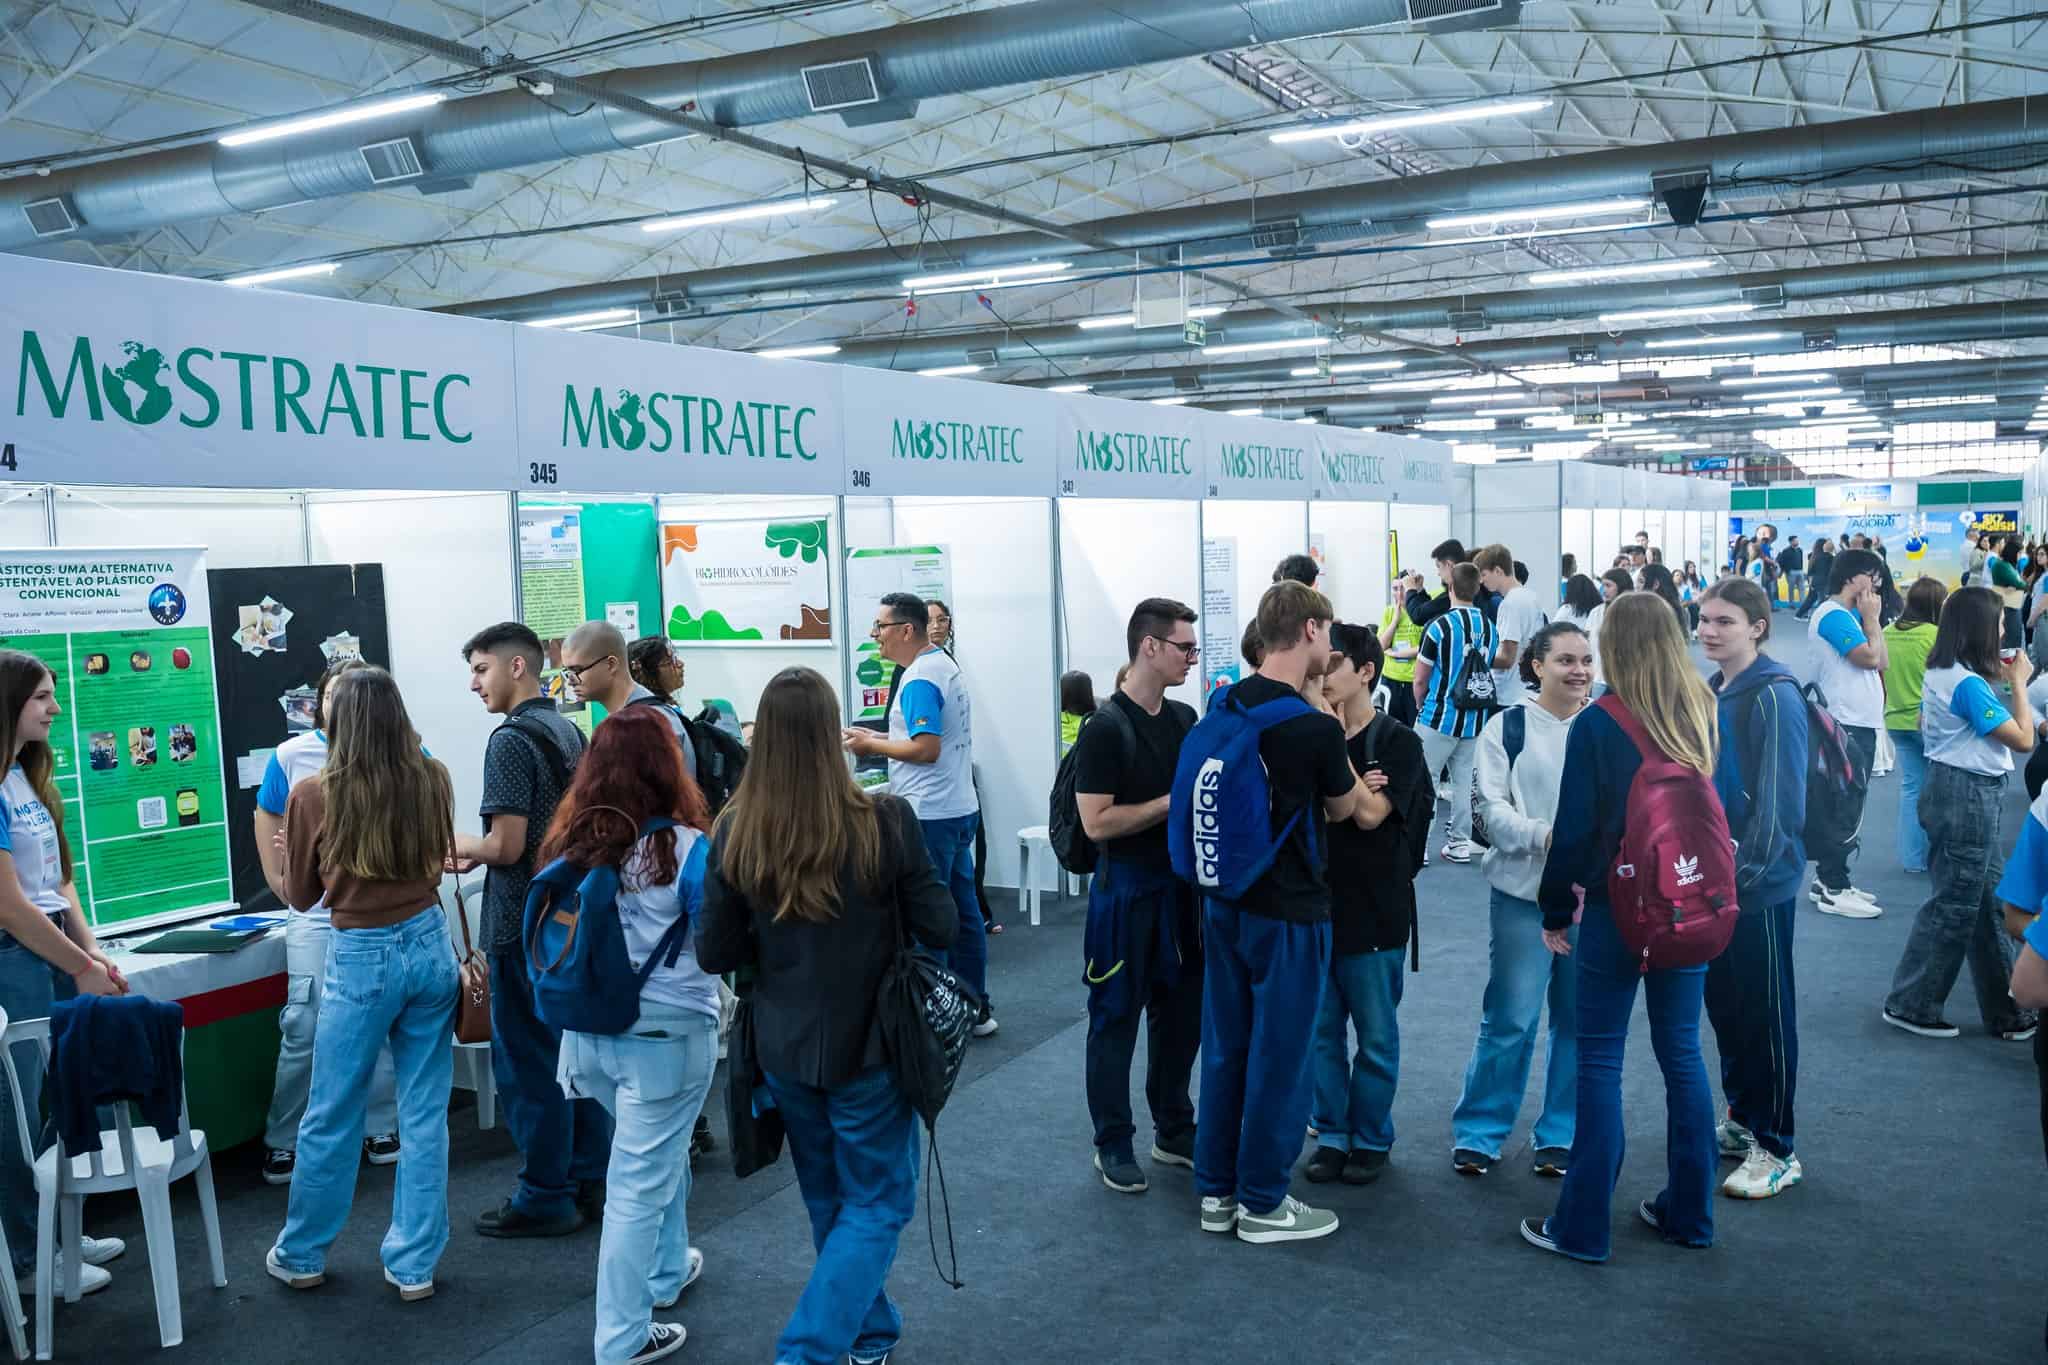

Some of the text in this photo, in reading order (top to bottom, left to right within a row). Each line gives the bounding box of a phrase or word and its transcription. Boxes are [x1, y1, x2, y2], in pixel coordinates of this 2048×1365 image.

[16, 330, 473, 444] MOSTRATEC
[562, 384, 817, 460] MOSTRATEC
[892, 418, 1023, 463] MOSTRATEC
[1076, 430, 1191, 475] MOSTRATEC
[0, 443, 18, 471] 4
[1221, 443, 1304, 480] MOSTRATEC
[530, 462, 557, 484] 345
[852, 470, 870, 487] 346
[59, 565, 87, 574] UMA
[91, 563, 173, 573] ALTERNATIVA
[75, 576, 93, 586] AO
[98, 573, 155, 585] PLÁSTICO
[19, 588, 120, 600] CONVENCIONAL
[1195, 771, 1219, 879] adidas
[1677, 873, 1704, 887] adidas
